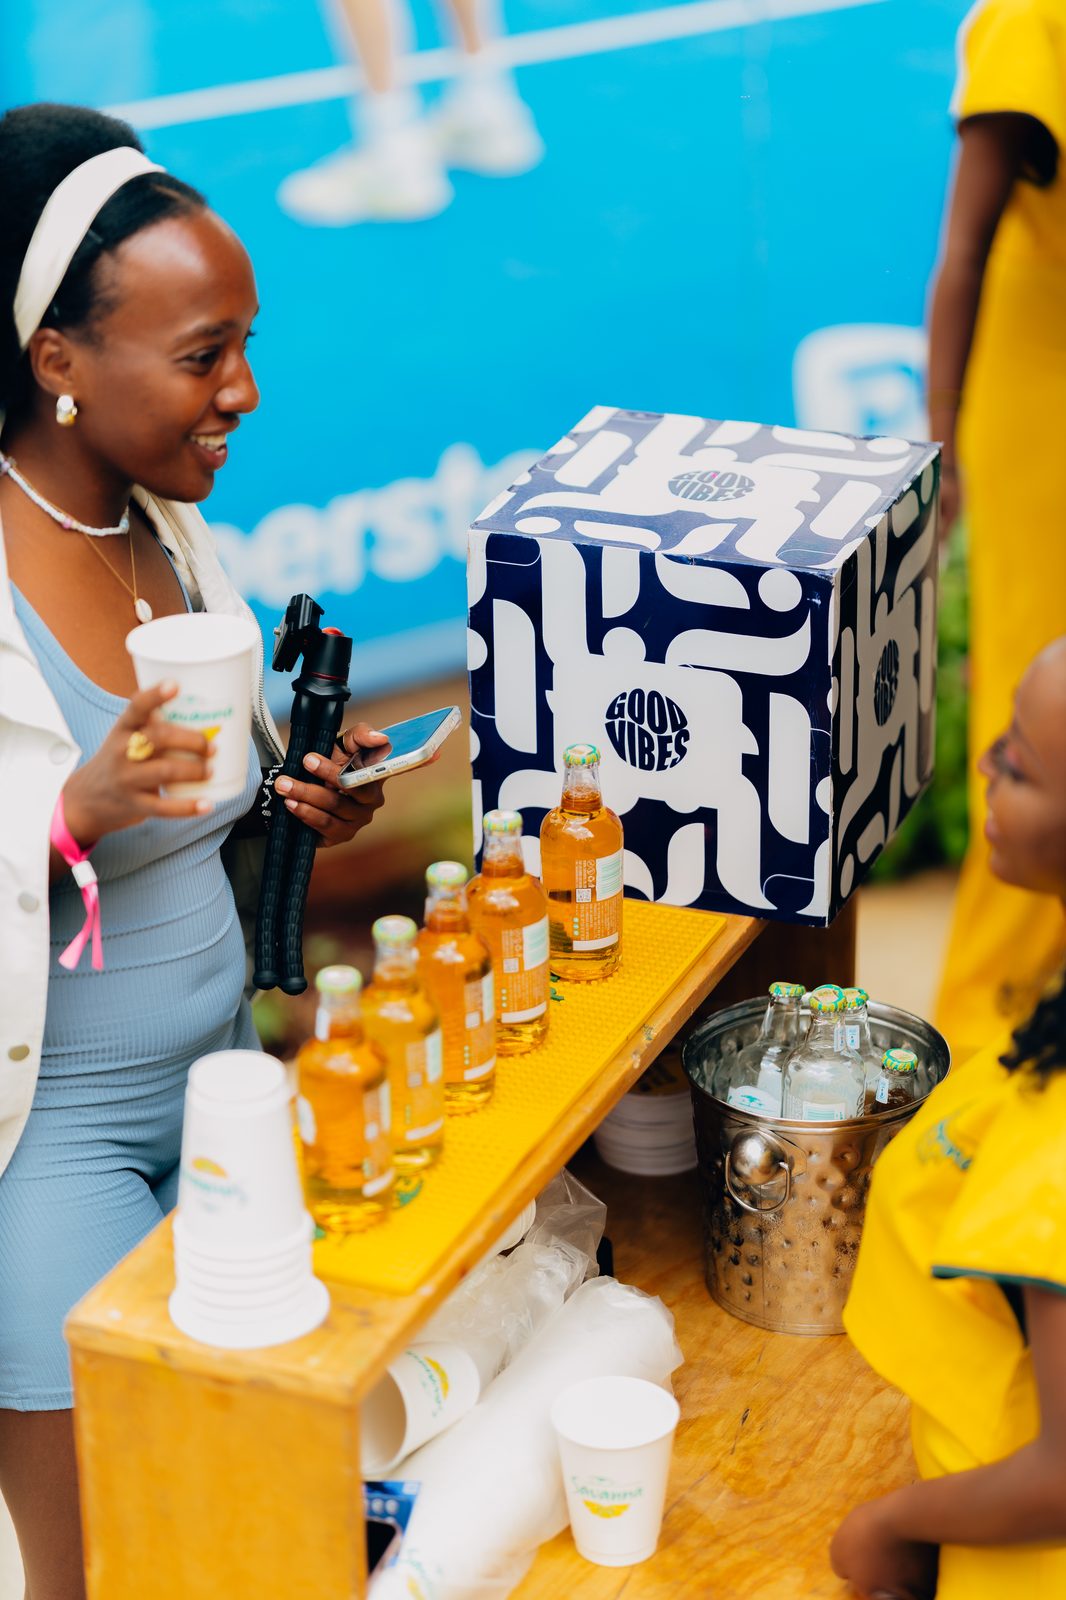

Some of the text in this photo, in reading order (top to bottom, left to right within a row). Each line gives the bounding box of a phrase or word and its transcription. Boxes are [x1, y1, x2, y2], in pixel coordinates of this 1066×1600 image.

[667, 479, 754, 502] VIBES
[671, 470, 756, 489] GOOD
[874, 638, 900, 695] GOOD
[605, 688, 689, 735] GOOD
[873, 676, 899, 727] VIBES
[604, 719, 691, 772] VIBES
[571, 1475, 645, 1502] Savanna
